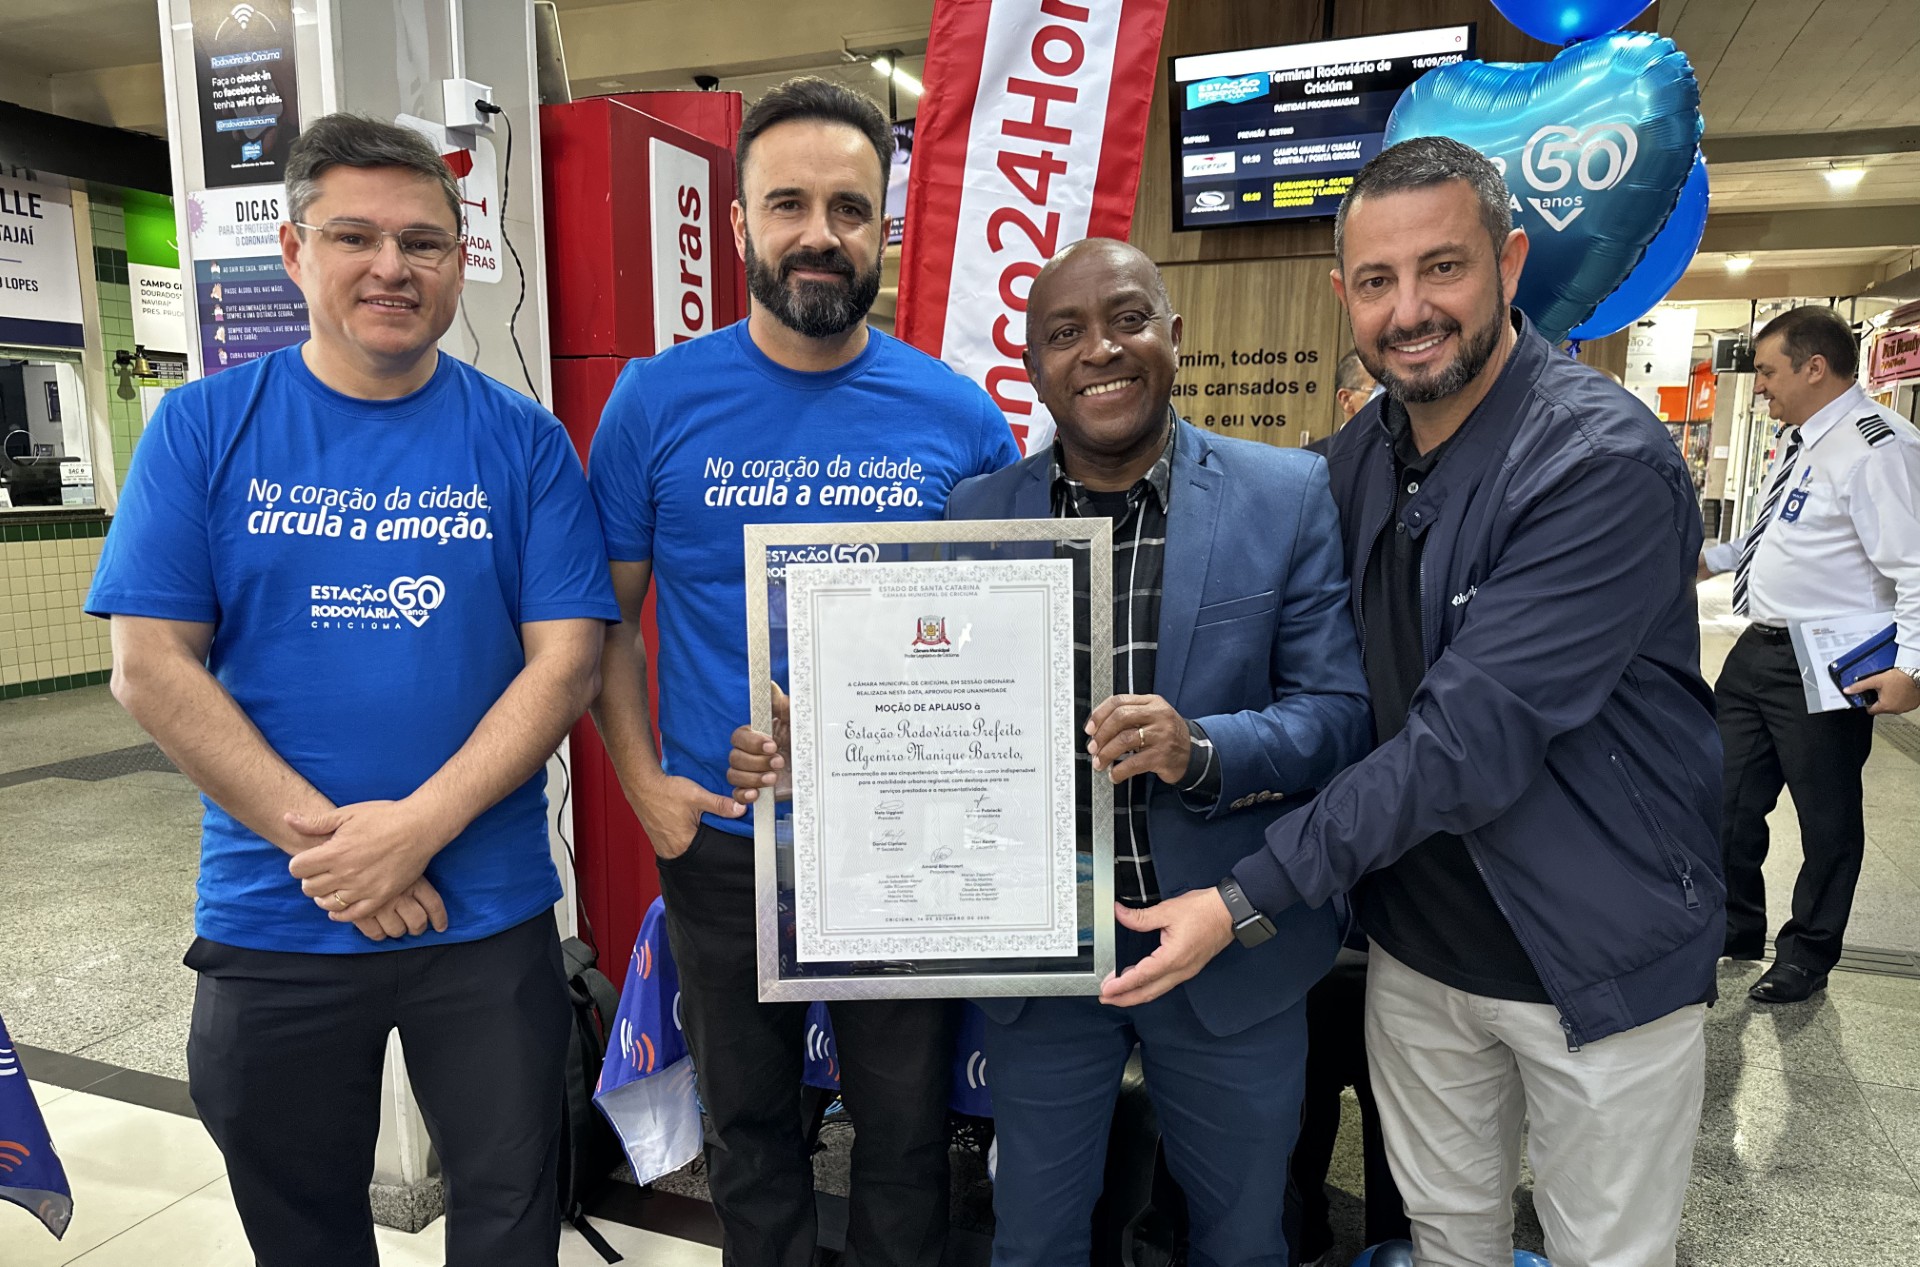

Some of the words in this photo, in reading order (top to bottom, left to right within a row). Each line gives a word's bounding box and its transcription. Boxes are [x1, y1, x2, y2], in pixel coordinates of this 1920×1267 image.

[244, 54, 252, 63] de
[212, 77, 230, 87] Faça
[236, 70, 272, 83] check-in
[1268, 67, 1315, 83] Terminal
[1317, 61, 1375, 78] Rodoviário
[1376, 59, 1392, 72] de
[213, 90, 224, 99] no
[223, 84, 261, 97] facebook
[1198, 78, 1261, 92] ESTAÇÃO
[1304, 79, 1353, 95] Criciúma
[213, 100, 236, 110] tenha
[236, 96, 255, 108] wi-fi
[255, 93, 282, 105] Grátis.
[1274, 101, 1306, 113] PARTIDAS
[1307, 97, 1360, 110] PROGRAMADAS
[1268, 127, 1294, 136] DESTINO
[1273, 147, 1299, 157] CAMPO
[1299, 144, 1326, 155] GRANDE
[1273, 155, 1305, 166] CURITIBA
[1309, 153, 1332, 163] PONTA
[1529, 132, 1631, 192] 50
[1541, 194, 1583, 209] anos
[236, 199, 279, 223] DICAS
[218, 225, 235, 236] PARA
[236, 224, 244, 235] SE
[244, 222, 275, 235] PROTEGER
[236, 236, 241, 247] O
[5, 276, 39, 292] LOPES
[140, 279, 171, 289] CAMPO
[1179, 351, 1226, 369] mim,
[1231, 348, 1288, 365] todos
[1294, 350, 1319, 364] os
[1204, 378, 1299, 397] cansados
[1305, 380, 1317, 394] e
[1204, 413, 1216, 427] e
[1221, 413, 1244, 427] eu
[1251, 413, 1286, 427] vos
[704, 456, 734, 479] No
[741, 456, 820, 483] coração
[826, 454, 851, 479] da
[858, 455, 926, 484] cidade,
[247, 478, 282, 503] No
[290, 484, 377, 513] coração
[384, 486, 411, 512] da
[418, 483, 492, 514] cidade,
[704, 477, 788, 507] circula
[795, 485, 811, 506] a
[819, 481, 924, 513] emoção.
[247, 502, 343, 538] circula
[350, 518, 367, 541] a
[376, 511, 494, 545] emoção.
[311, 584, 388, 605] ESTAÇÃO
[393, 580, 442, 611] 50
[311, 604, 400, 619] RODOVIÁRIA
[407, 609, 428, 617] anos
[311, 621, 402, 630] CRICIÚMA
[875, 702, 911, 714] MOÇÃO
[914, 703, 926, 712] DE
[929, 702, 972, 712] APLAUSO
[844, 720, 894, 745] Estação
[897, 718, 970, 739] Rodoviária
[972, 717, 1022, 742] Prefeito
[845, 743, 904, 770] Algemiro
[906, 741, 966, 765] Manique
[968, 740, 1023, 761] Barreto,
